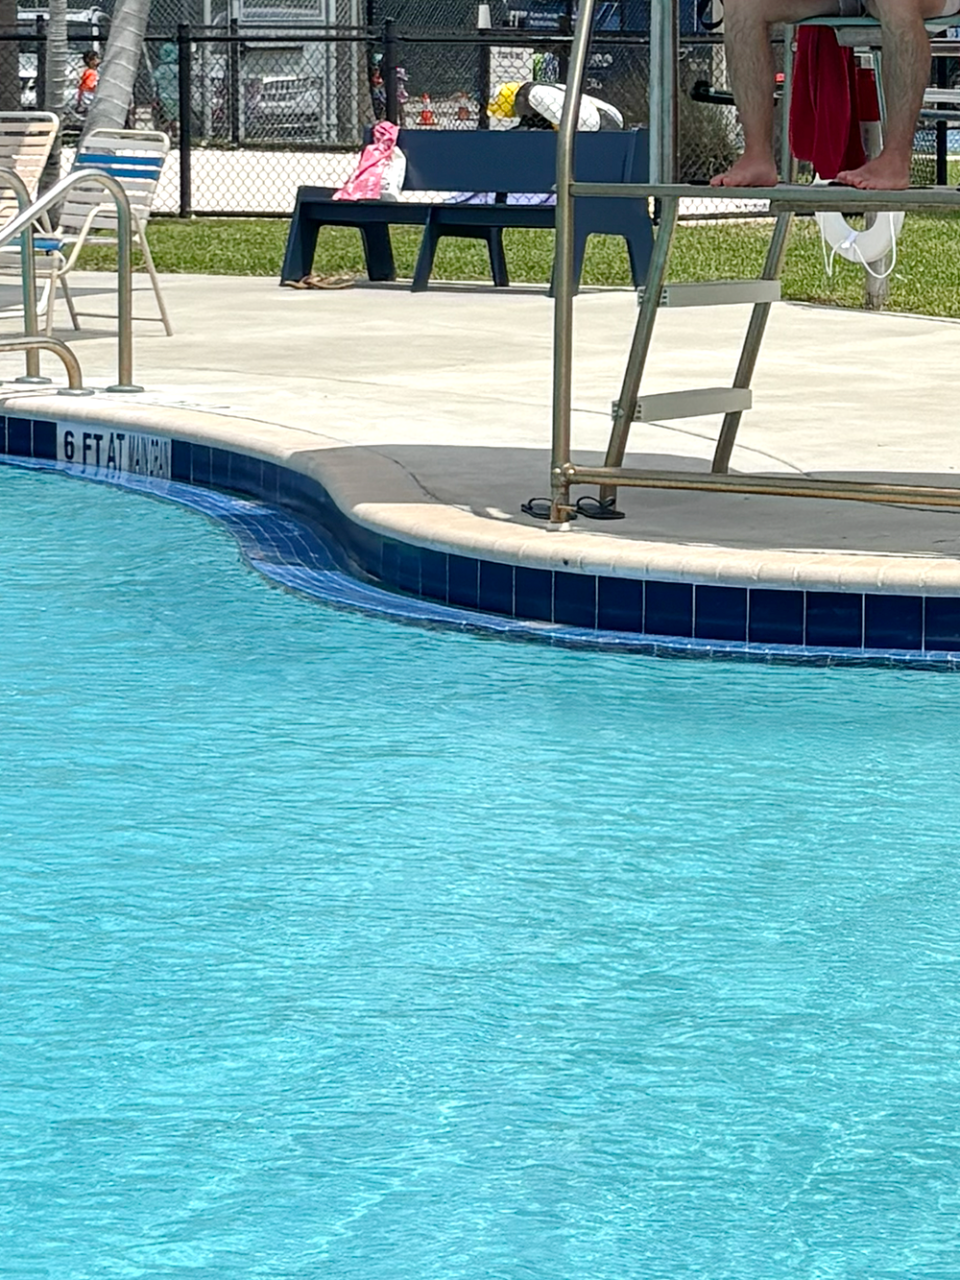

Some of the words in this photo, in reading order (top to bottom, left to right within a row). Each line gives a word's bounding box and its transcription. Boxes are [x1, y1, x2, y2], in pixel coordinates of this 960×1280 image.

[64, 430, 75, 461] 6
[82, 432, 103, 467] FT
[107, 432, 125, 472] AT
